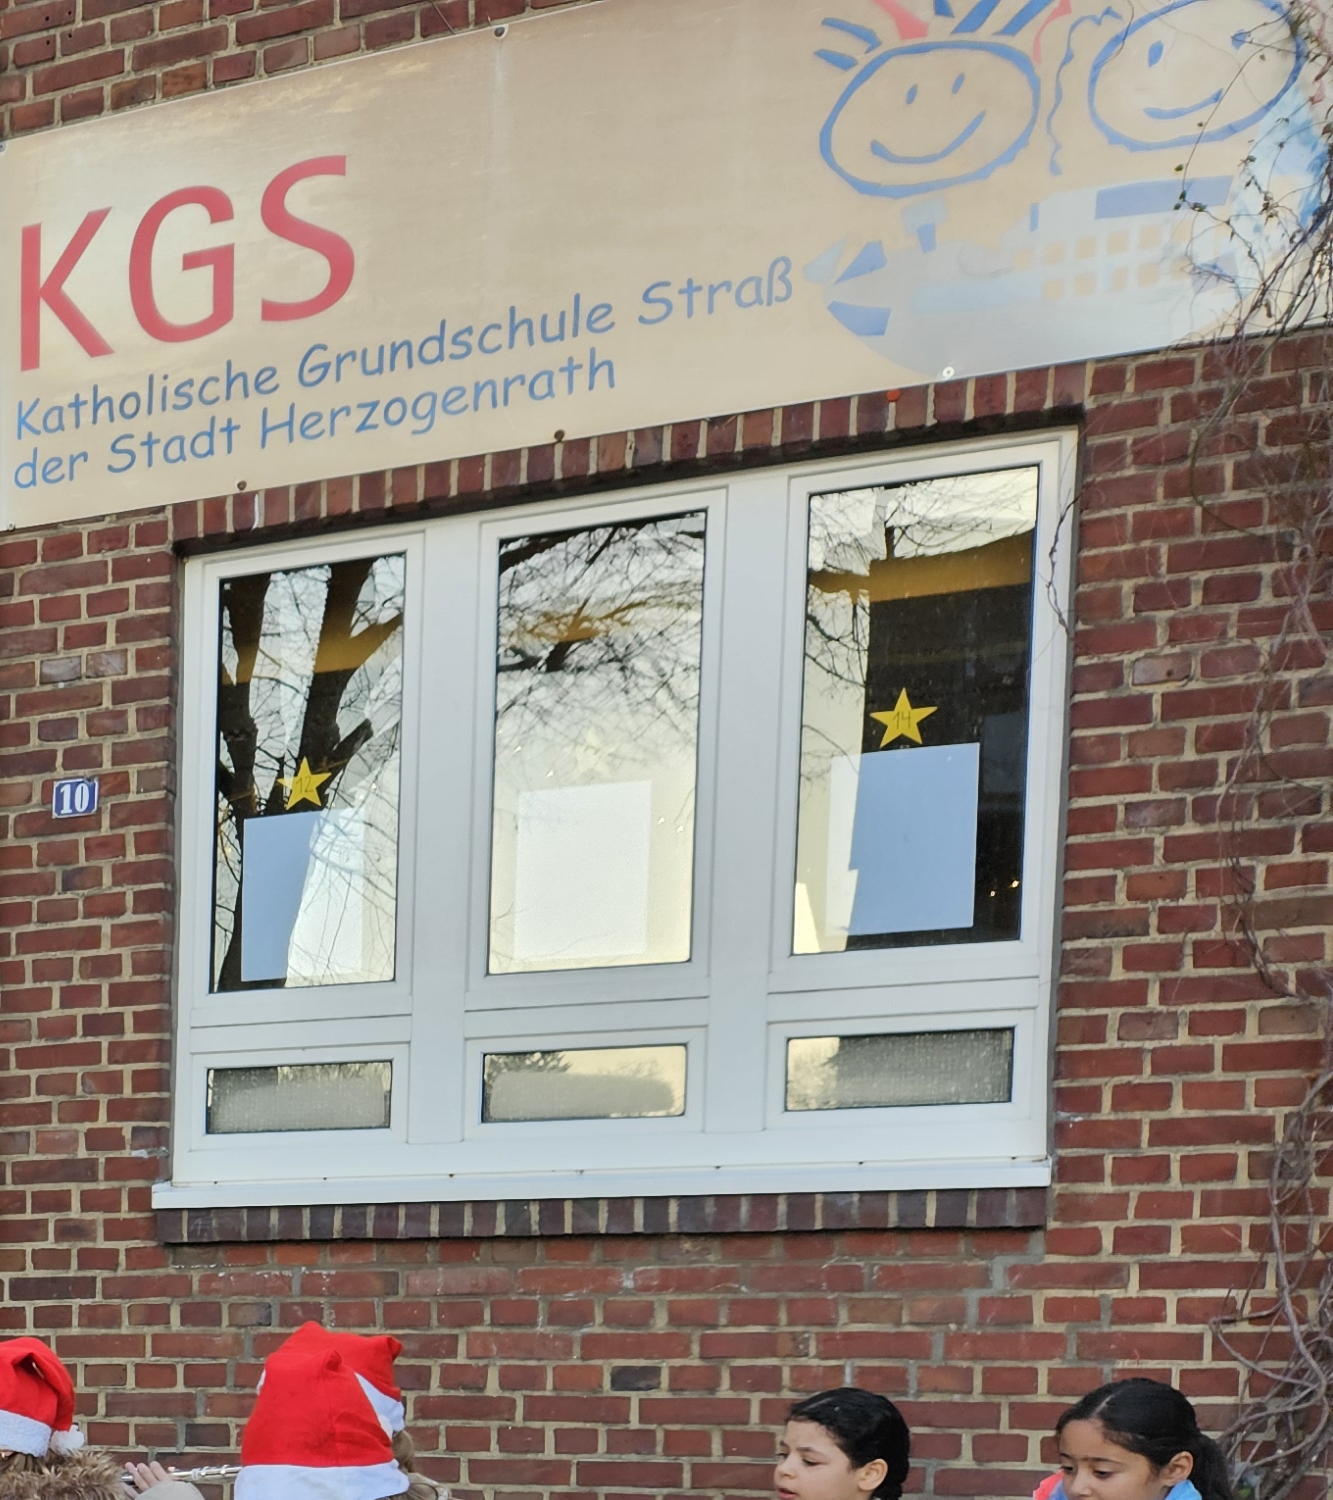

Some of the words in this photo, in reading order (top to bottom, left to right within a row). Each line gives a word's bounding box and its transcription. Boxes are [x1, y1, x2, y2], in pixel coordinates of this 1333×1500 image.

[20, 154, 355, 372] KGS
[15, 359, 280, 441] Katholische
[297, 293, 616, 388] Grundschule
[637, 256, 794, 326] Straß
[14, 447, 88, 490] der
[107, 415, 241, 474] Stadt
[260, 346, 616, 451] Herzogenrath
[893, 710, 911, 730] 14
[60, 783, 90, 814] 10
[295, 775, 314, 794] 12
